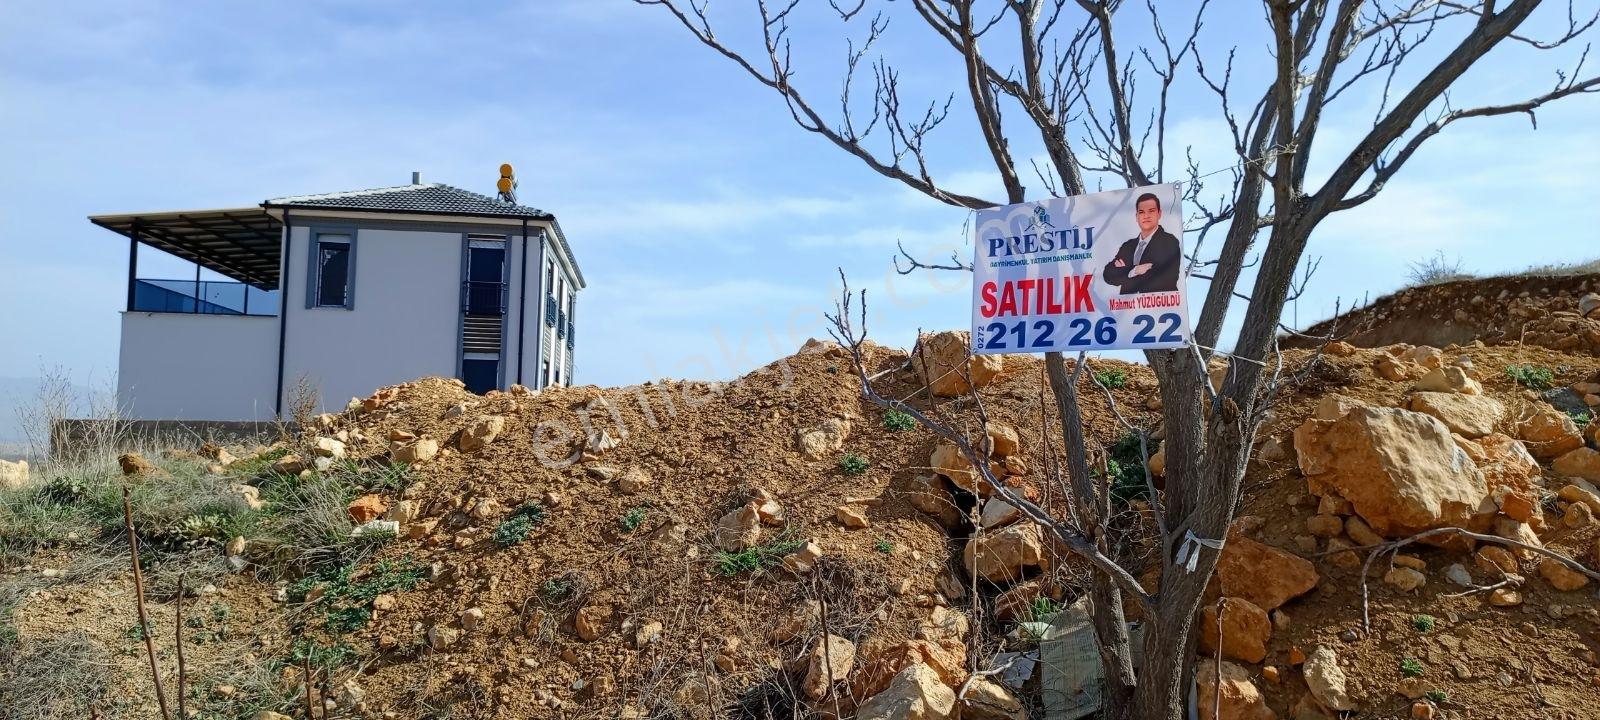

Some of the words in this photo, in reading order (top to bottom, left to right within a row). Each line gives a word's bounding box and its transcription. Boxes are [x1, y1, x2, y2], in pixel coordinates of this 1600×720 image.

[981, 274, 1096, 318] SATILIK
[1109, 298, 1136, 311] Mahmut
[977, 325, 985, 349] 0272
[985, 320, 1054, 350] 212
[1068, 316, 1117, 347] 26
[1132, 313, 1182, 344] 22
